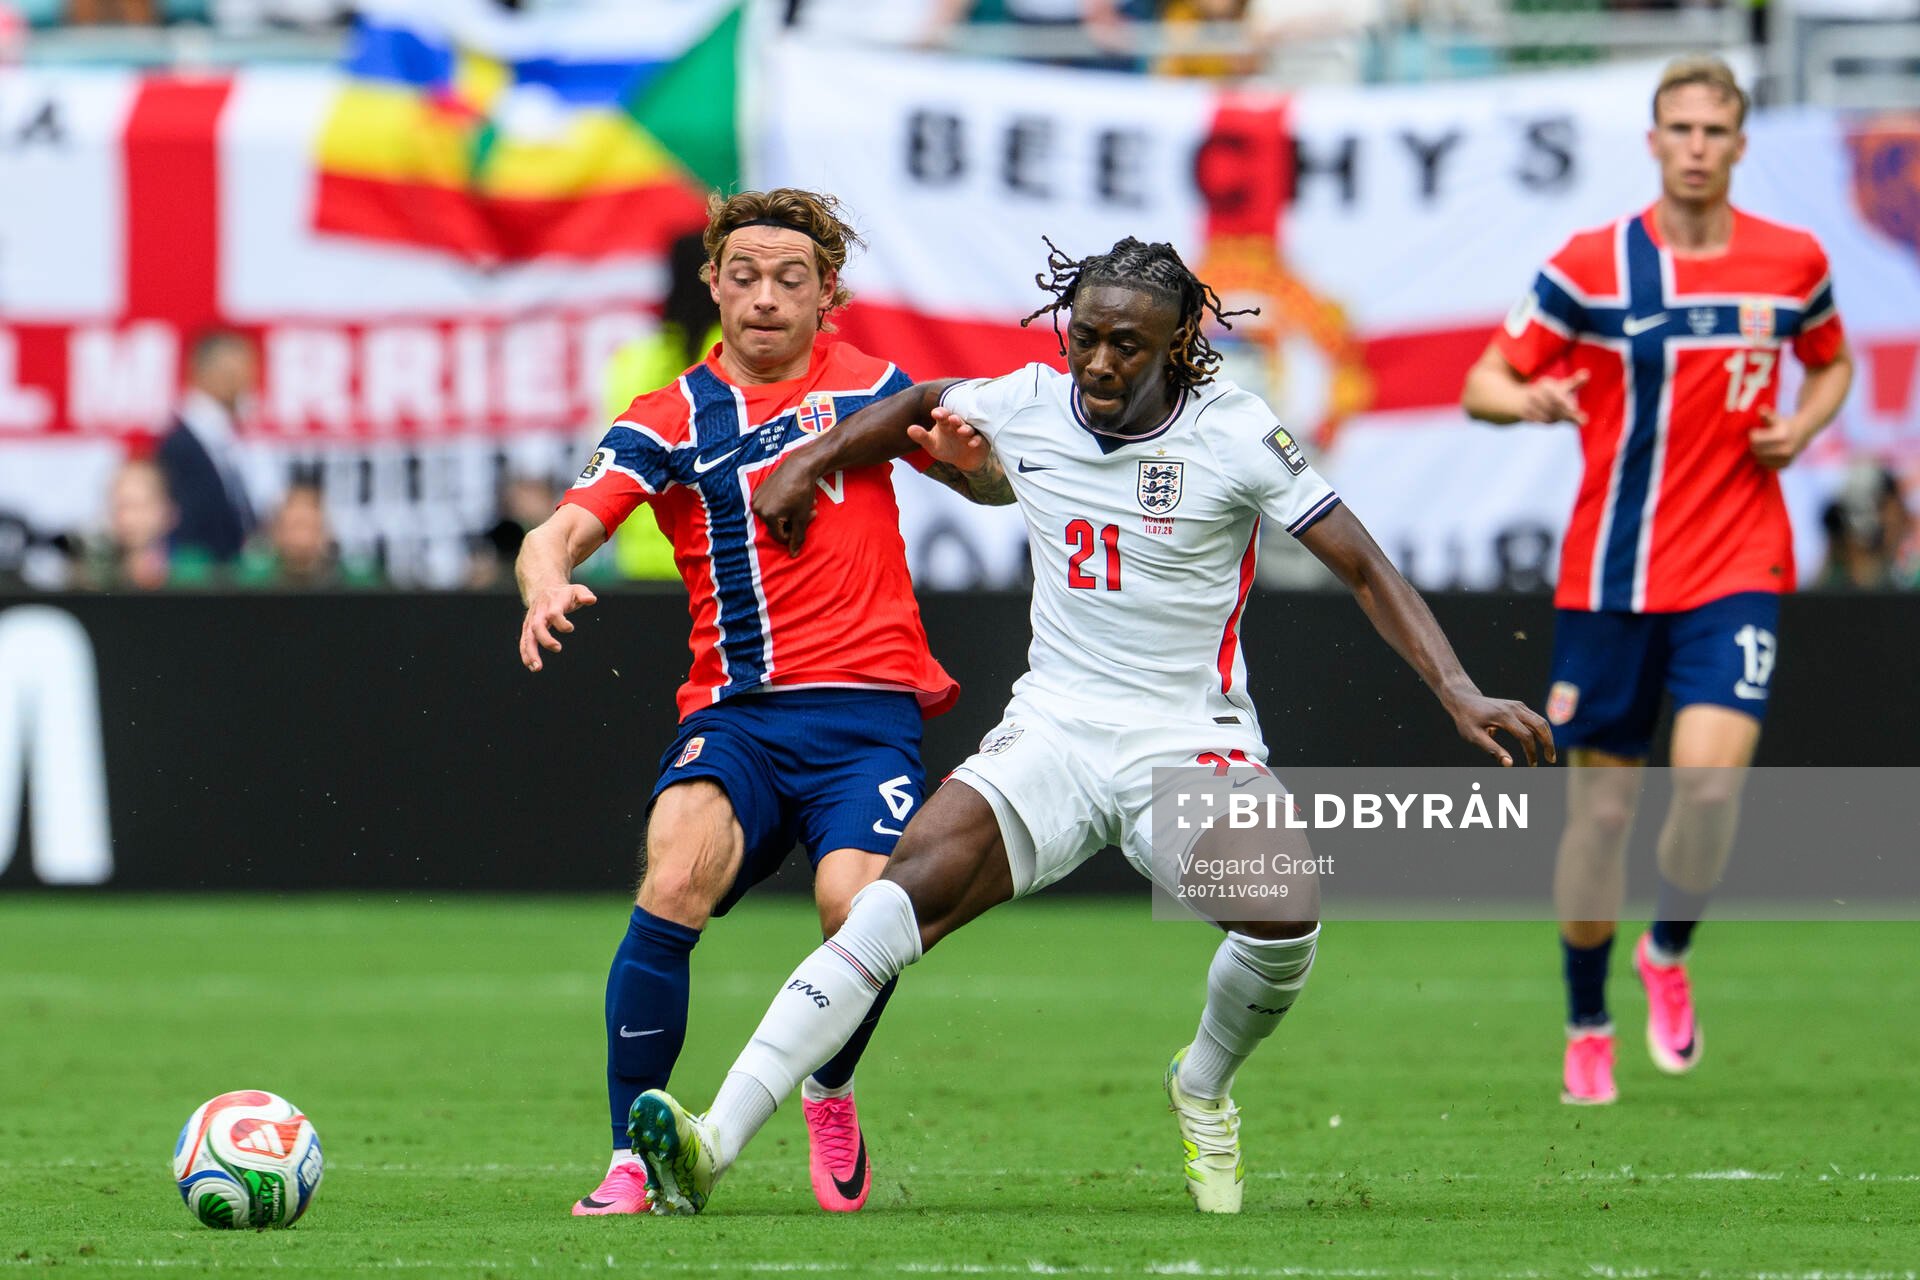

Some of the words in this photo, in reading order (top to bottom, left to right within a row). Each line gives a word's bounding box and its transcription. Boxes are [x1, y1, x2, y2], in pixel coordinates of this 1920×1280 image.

[1724, 350, 1776, 412] 17
[1142, 515, 1175, 524] NORWAY
[1145, 525, 1173, 535] 11.07.26
[1065, 518, 1122, 591] 21
[878, 774, 914, 822] 6
[787, 979, 830, 1009] ENG
